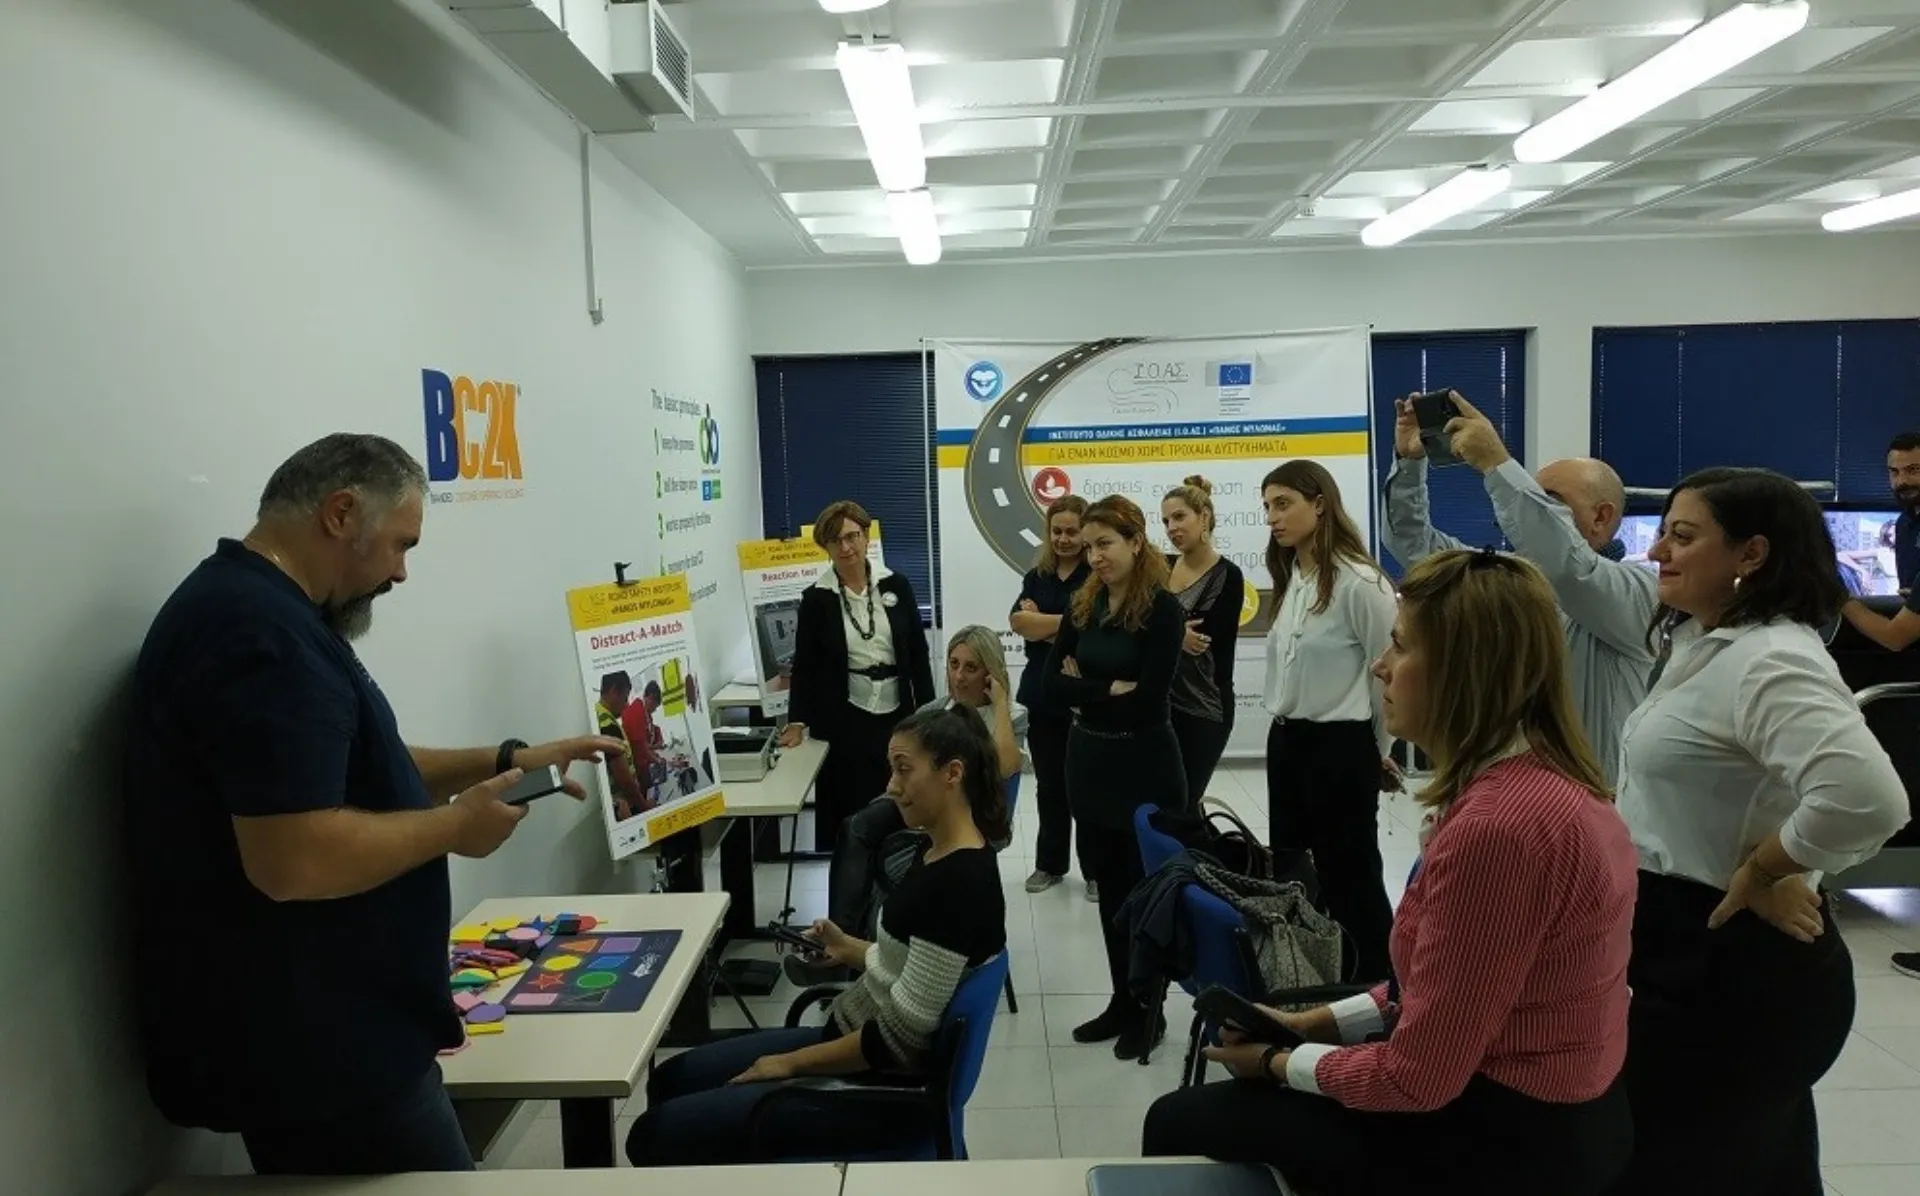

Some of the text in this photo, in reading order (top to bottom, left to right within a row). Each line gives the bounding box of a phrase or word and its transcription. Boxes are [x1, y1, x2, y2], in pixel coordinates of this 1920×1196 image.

[1068, 448, 1096, 460] ΕΝΑΝ
[1083, 476, 1142, 498] δράσεις
[762, 567, 817, 583] Reaction test
[590, 619, 684, 651] Distract-A-Match
